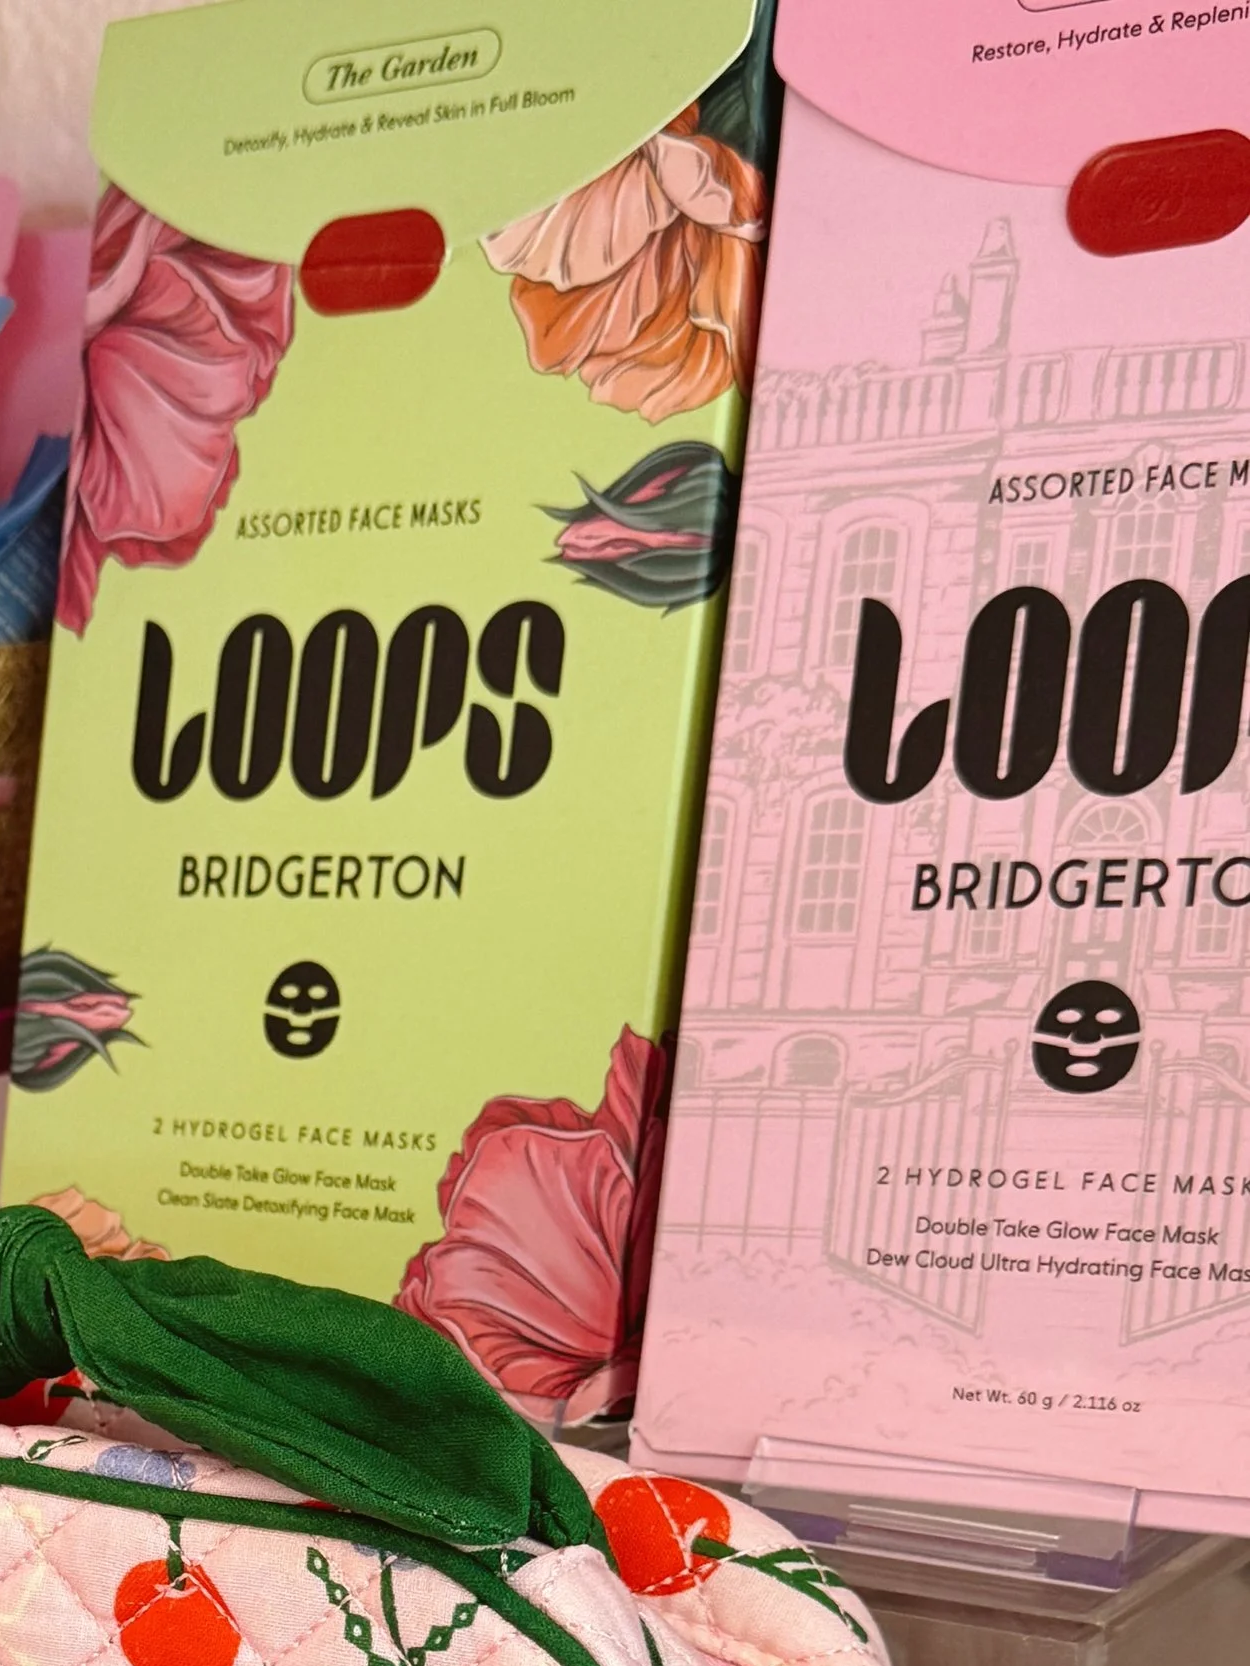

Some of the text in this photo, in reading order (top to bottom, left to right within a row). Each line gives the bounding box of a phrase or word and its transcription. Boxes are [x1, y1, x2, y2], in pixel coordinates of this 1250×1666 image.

[972, 0, 1250, 63] Restore, Hydrate & Repleni
[326, 46, 478, 92] The Garden
[224, 87, 575, 156] Detoxify, Hydrate & Reveal Skin in Full Bloom
[989, 467, 1134, 505] ASSORTED
[1145, 461, 1218, 491] FACE
[236, 499, 482, 540] ASSORTED FACE MASKS
[131, 599, 566, 804] LOOPS
[178, 855, 466, 899] BRIDGERTON
[153, 1117, 438, 1151] 2 HYDROGEL FACE MASKS
[180, 1161, 397, 1192] Double Take Glow Face Mask
[877, 1166, 890, 1185] 2
[905, 1167, 1065, 1190] HYDROGEL
[1081, 1172, 1158, 1193] FACE
[157, 1189, 415, 1224] Clean Slate Detoxifying Face Mask
[915, 1216, 1220, 1245] Double Take Glow Face Mask
[866, 1248, 909, 1267] Dew
[915, 1249, 974, 1270] Cloud
[980, 1252, 1030, 1273] Ultra
[1037, 1256, 1143, 1282] Hydrating
[1150, 1260, 1201, 1280] Face
[952, 1387, 1141, 1413] Net Wt. 60 g / 2.116 oz
